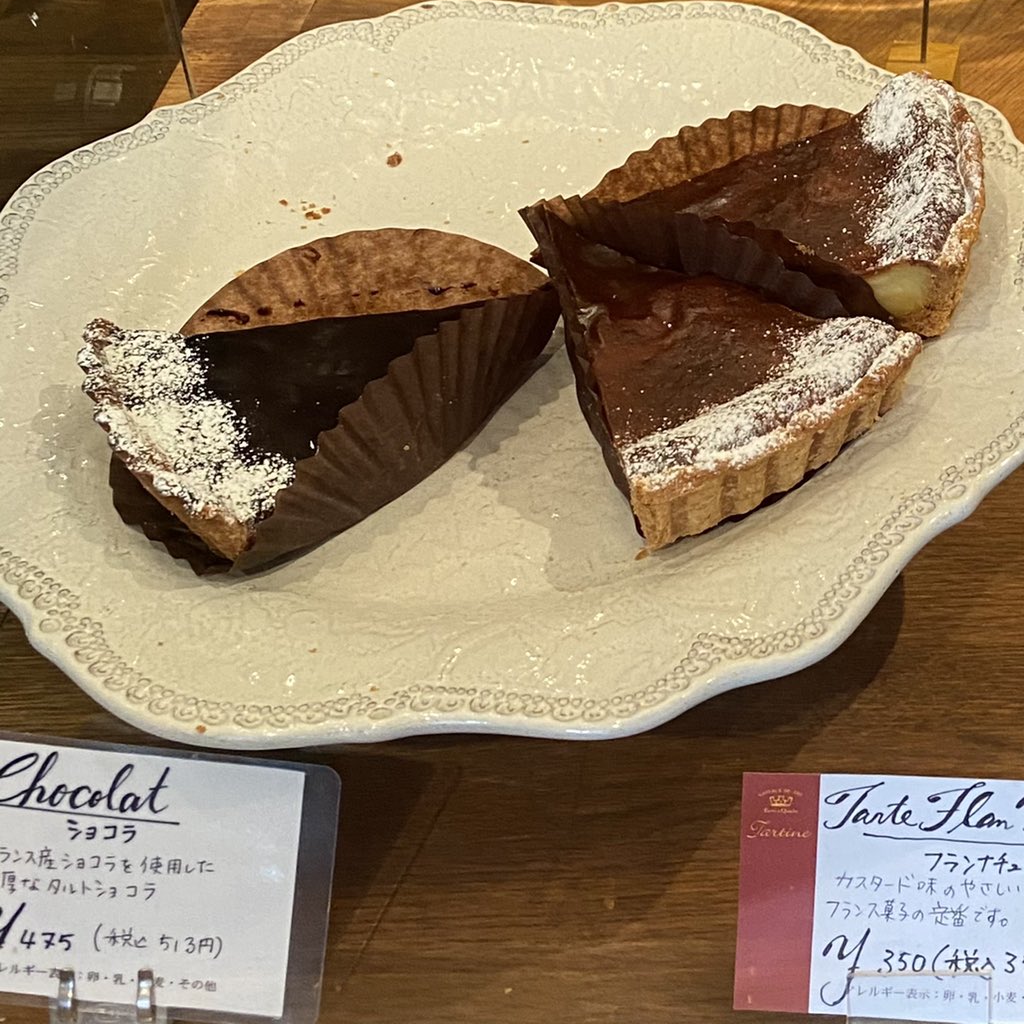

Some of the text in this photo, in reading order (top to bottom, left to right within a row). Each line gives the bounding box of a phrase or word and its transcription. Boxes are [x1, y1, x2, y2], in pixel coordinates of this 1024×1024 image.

[0, 750, 171, 814] Chocolat
[823, 781, 918, 830] Tarte
[919, 781, 1014, 834] Flan
[66, 818, 138, 844] ショコラ
[747, 819, 813, 839] Tartine
[825, 898, 1011, 928] フランス菓子の定番です。
